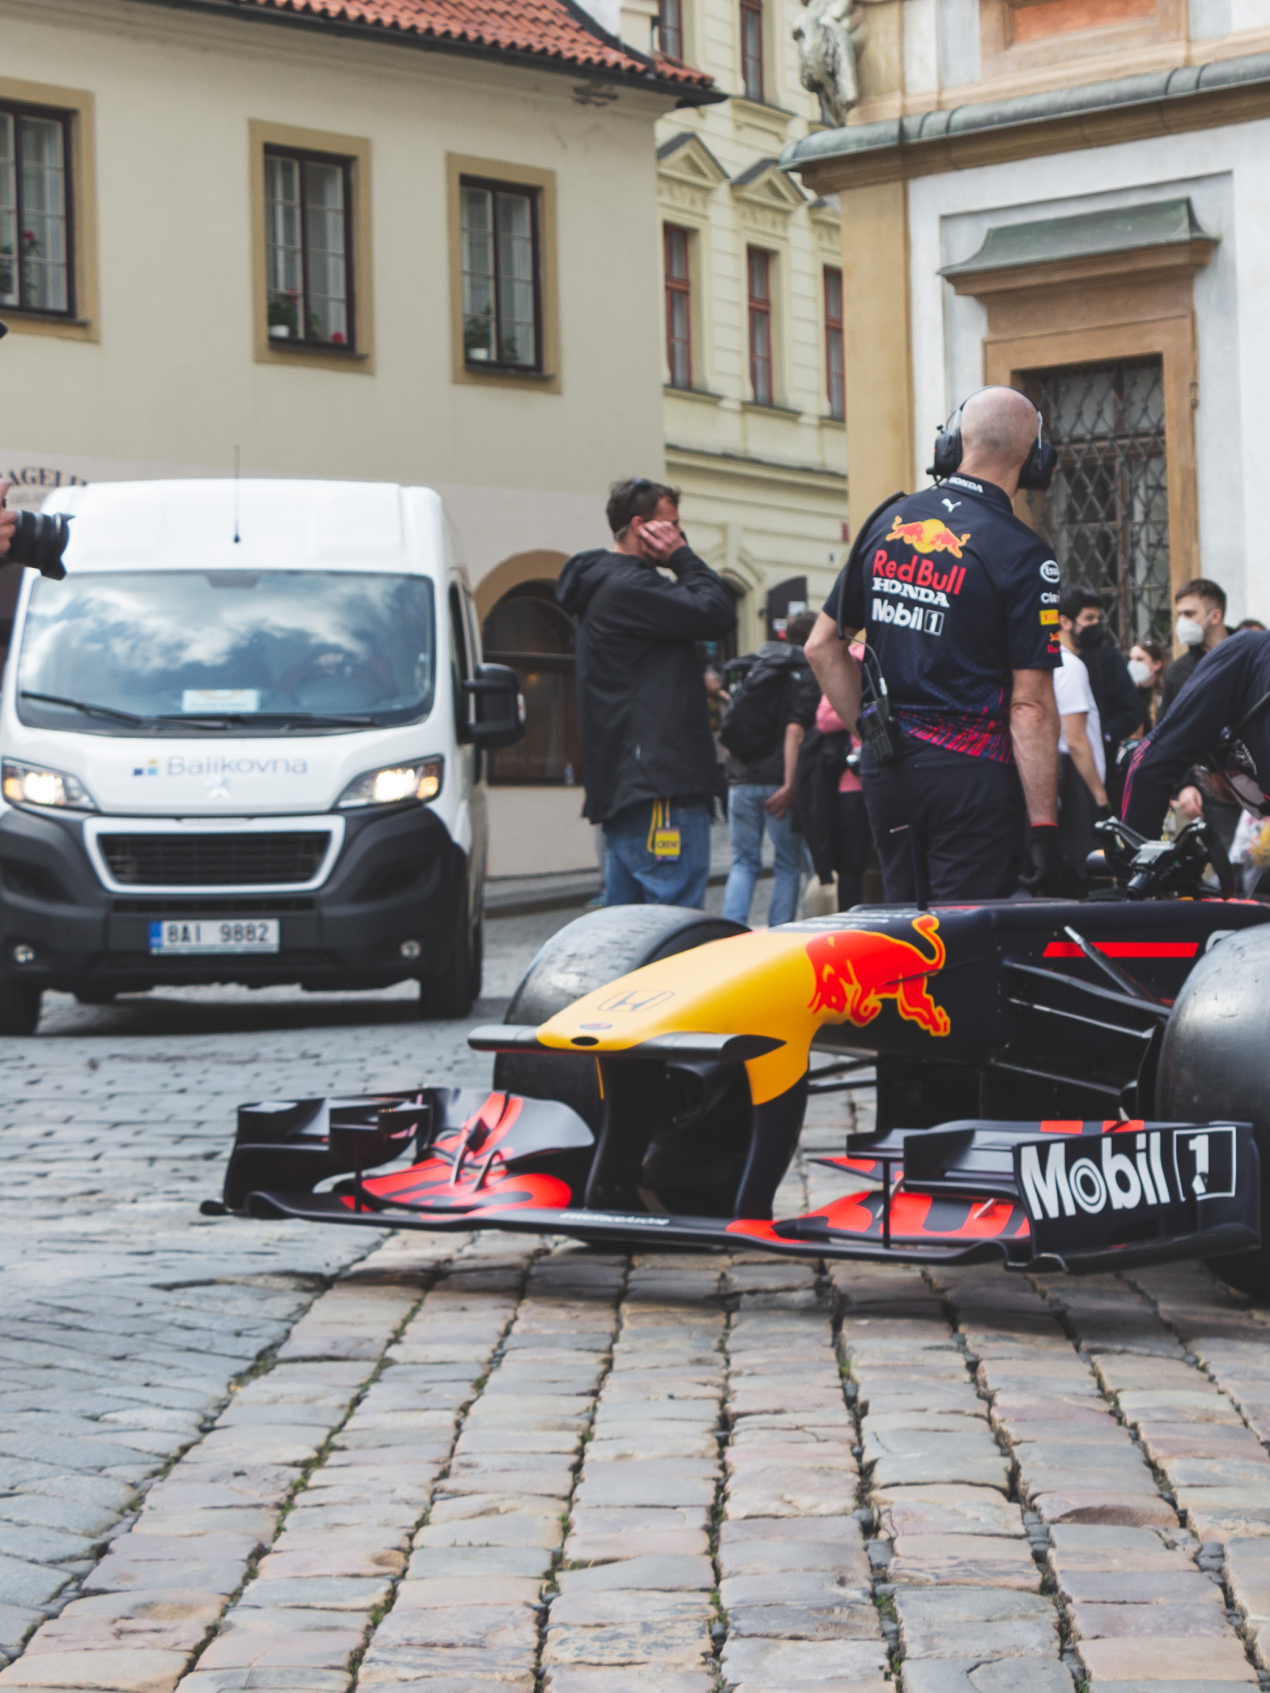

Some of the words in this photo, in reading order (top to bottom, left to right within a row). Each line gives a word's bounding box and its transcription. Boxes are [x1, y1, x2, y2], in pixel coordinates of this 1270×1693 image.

[948, 476, 984, 493] HONDA
[871, 577, 950, 608] HONDA
[871, 598, 924, 631] Mobil
[166, 754, 308, 776] Balíkovna
[219, 923, 270, 943] 9882
[1020, 1131, 1171, 1221] Mobil
